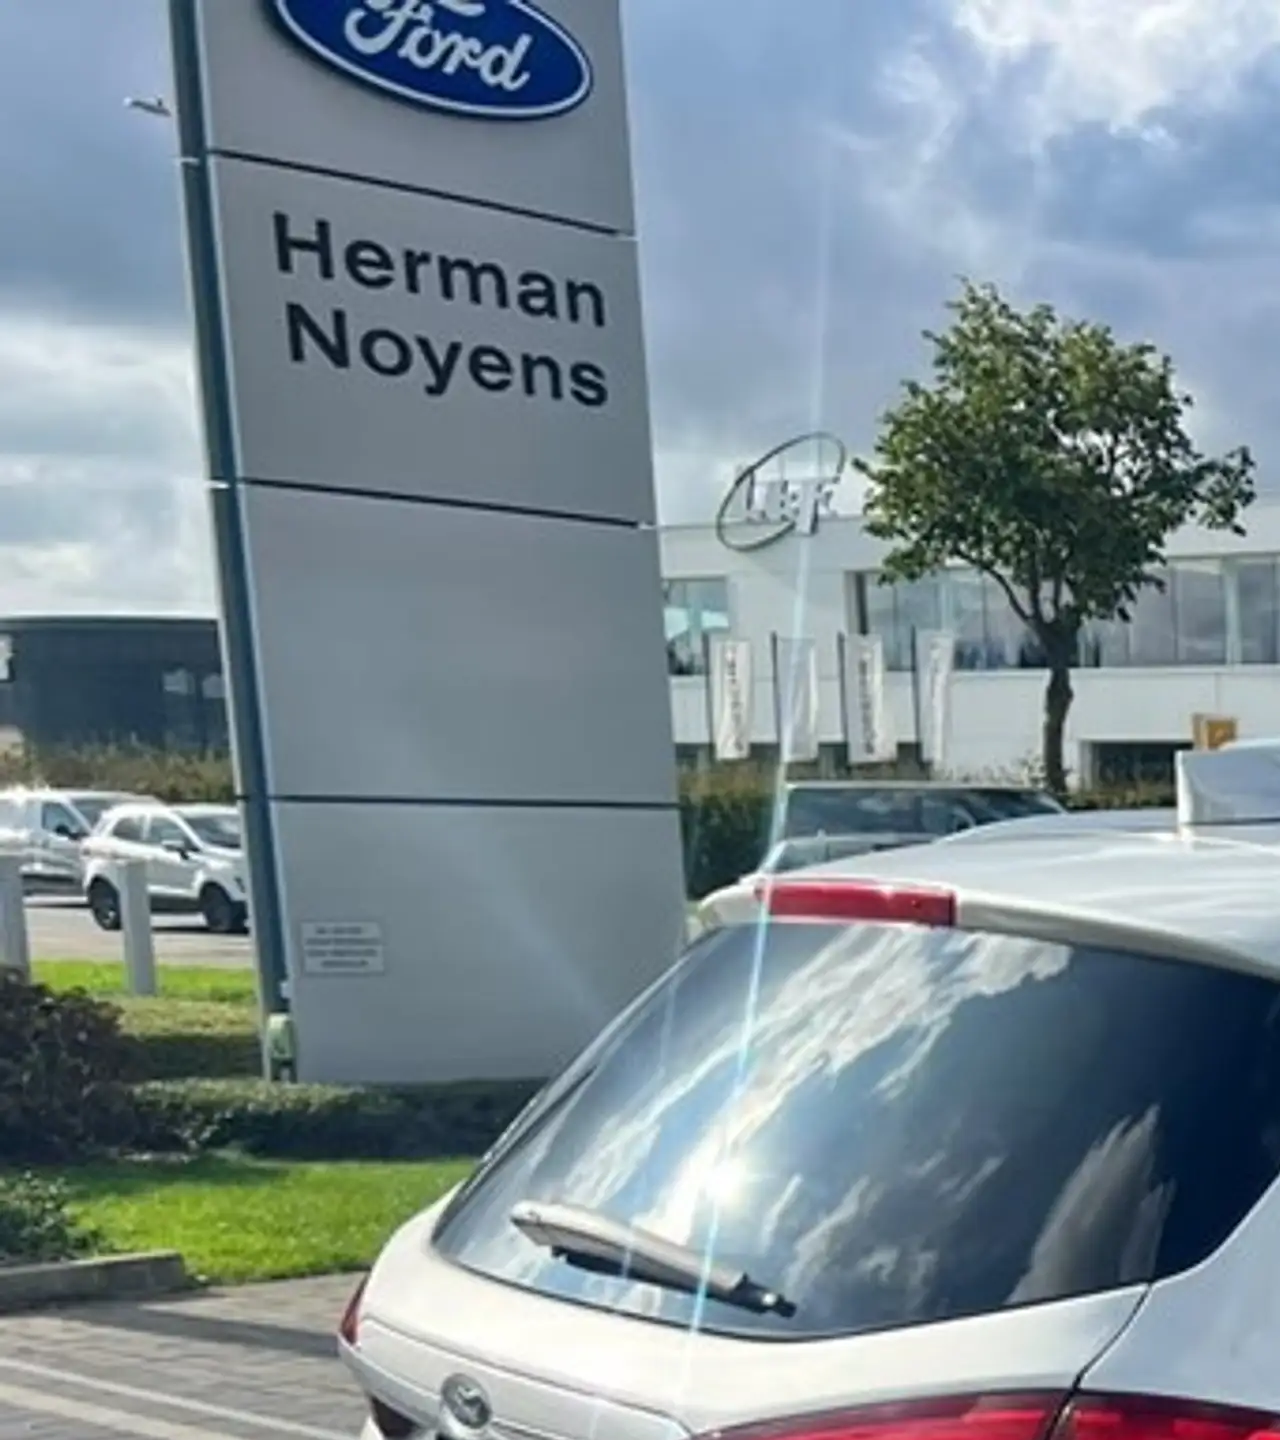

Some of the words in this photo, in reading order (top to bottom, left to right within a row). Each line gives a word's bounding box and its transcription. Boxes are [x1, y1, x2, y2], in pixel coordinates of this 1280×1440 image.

[343, 0, 533, 92] Ford
[272, 211, 607, 328] Herman
[285, 302, 609, 407] Noyens
